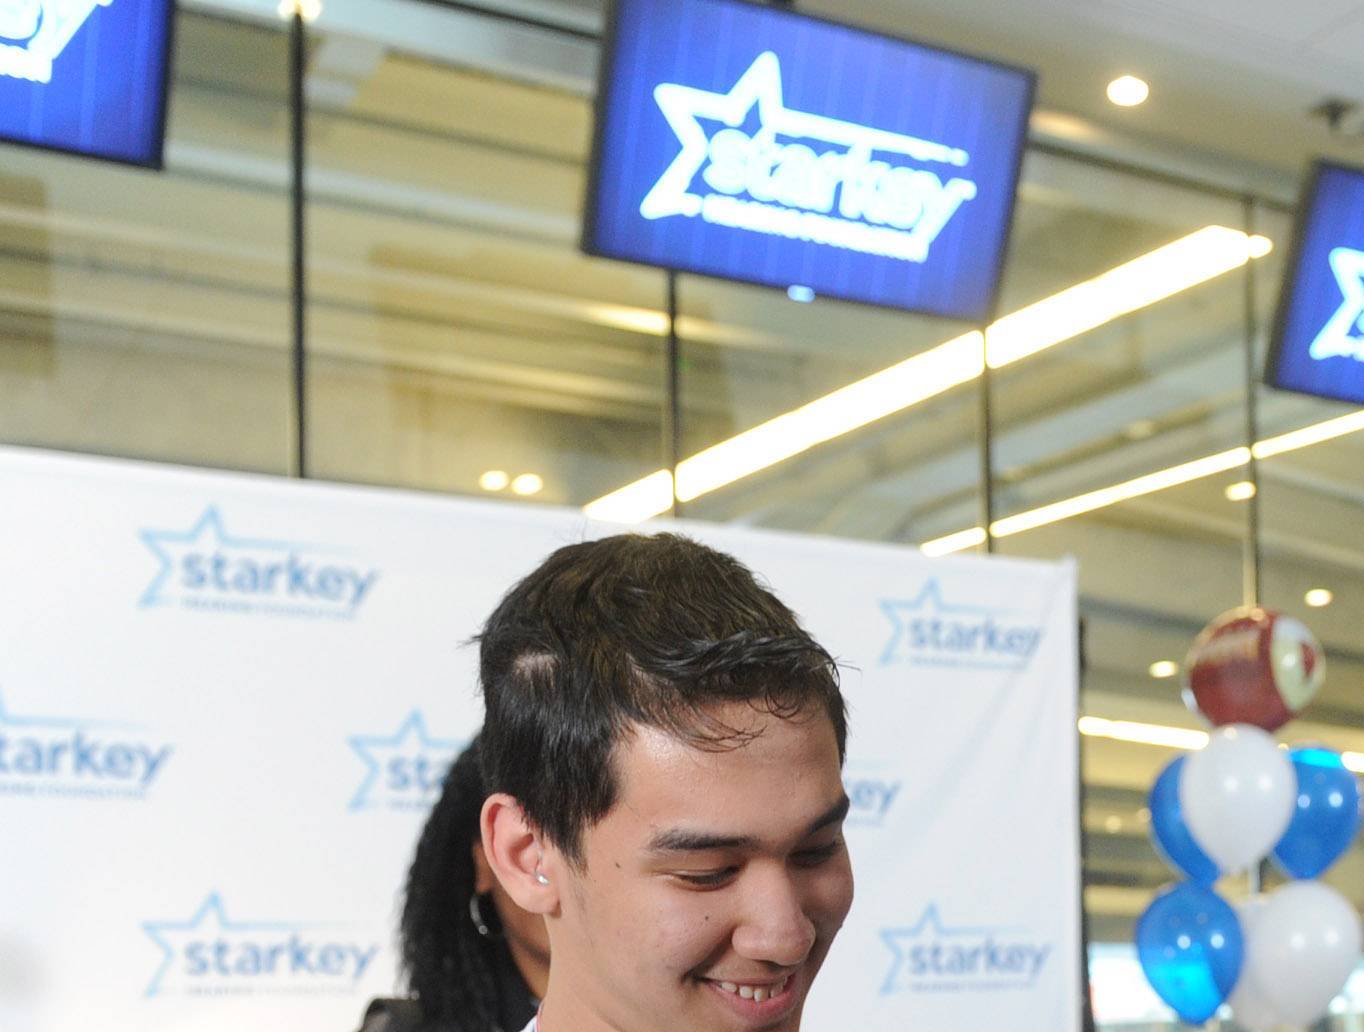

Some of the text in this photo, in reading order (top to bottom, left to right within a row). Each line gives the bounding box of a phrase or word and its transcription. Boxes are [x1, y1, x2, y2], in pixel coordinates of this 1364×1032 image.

[182, 552, 379, 609] starkey
[910, 614, 1045, 659] starkey
[0, 729, 175, 786] tarkey
[184, 934, 379, 983] starkey
[909, 936, 1051, 983] starkey
